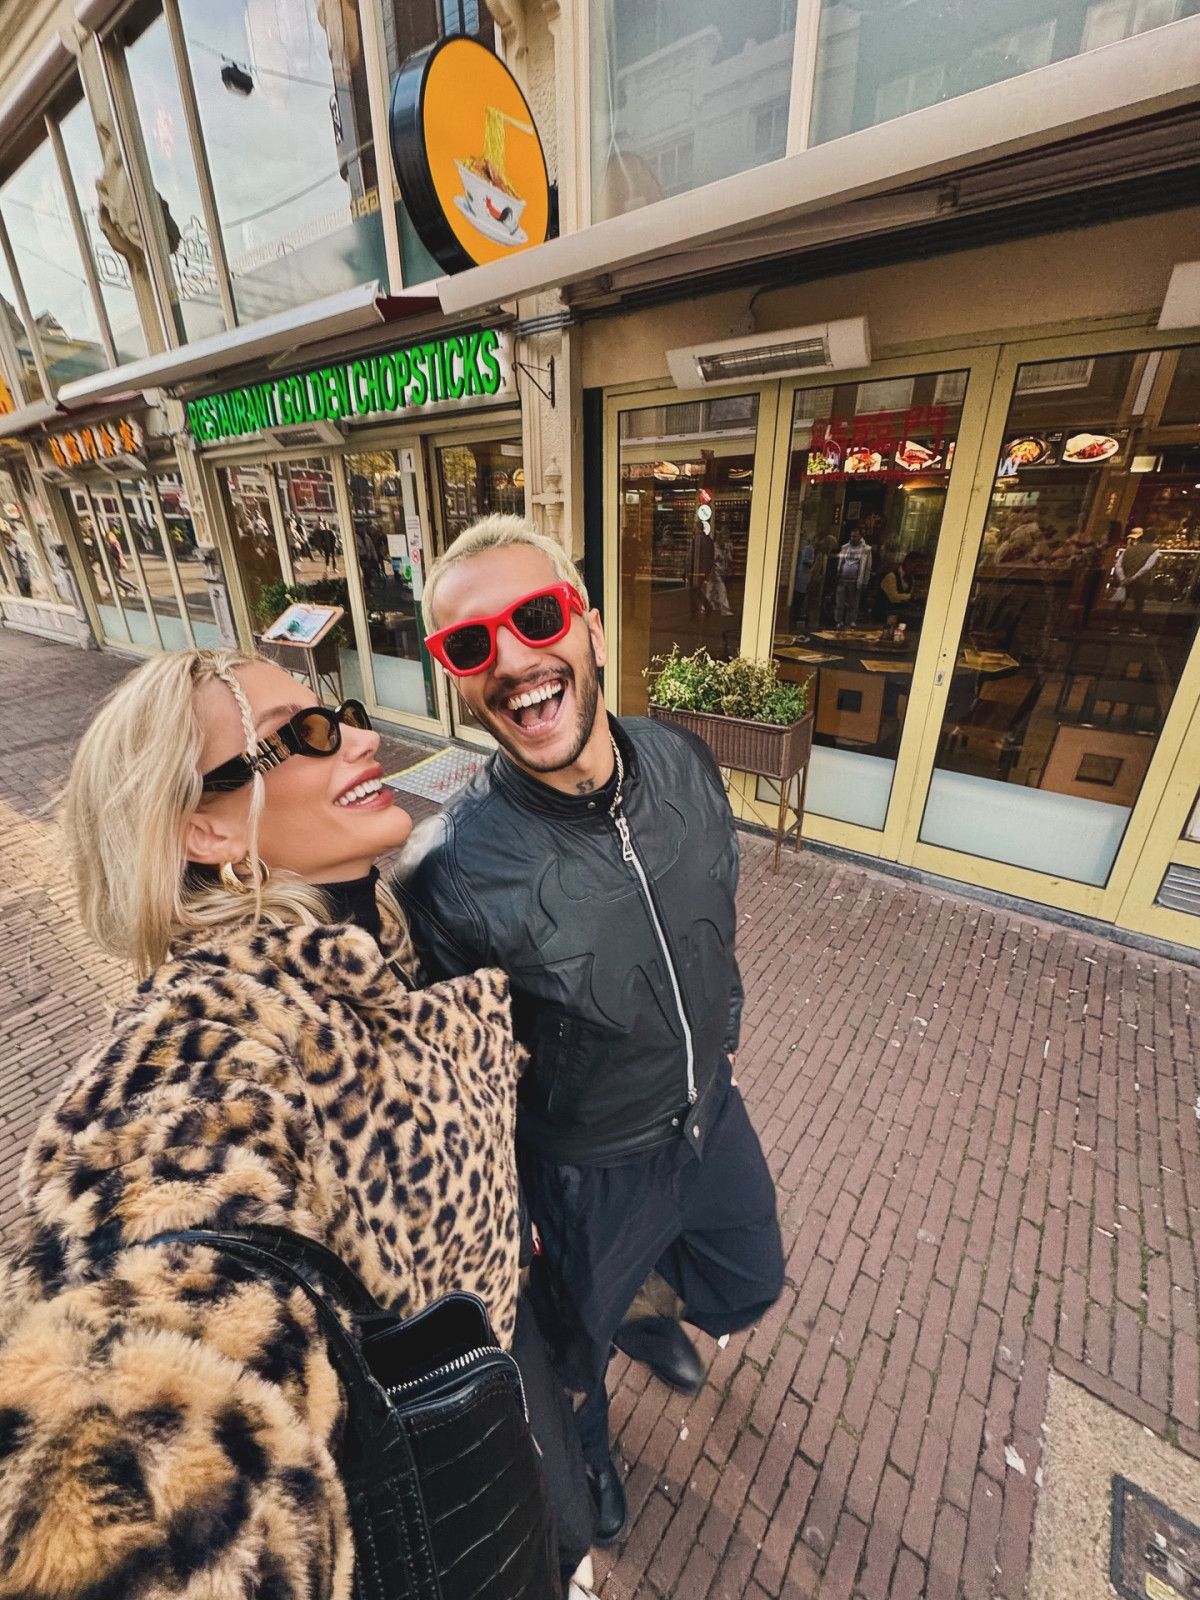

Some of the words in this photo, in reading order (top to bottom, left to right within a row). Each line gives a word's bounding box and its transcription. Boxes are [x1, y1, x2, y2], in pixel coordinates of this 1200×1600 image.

[187, 383, 276, 442] RESTAURANT
[276, 364, 350, 426] GOLDEN
[351, 329, 501, 415] CHOPSTICKS
